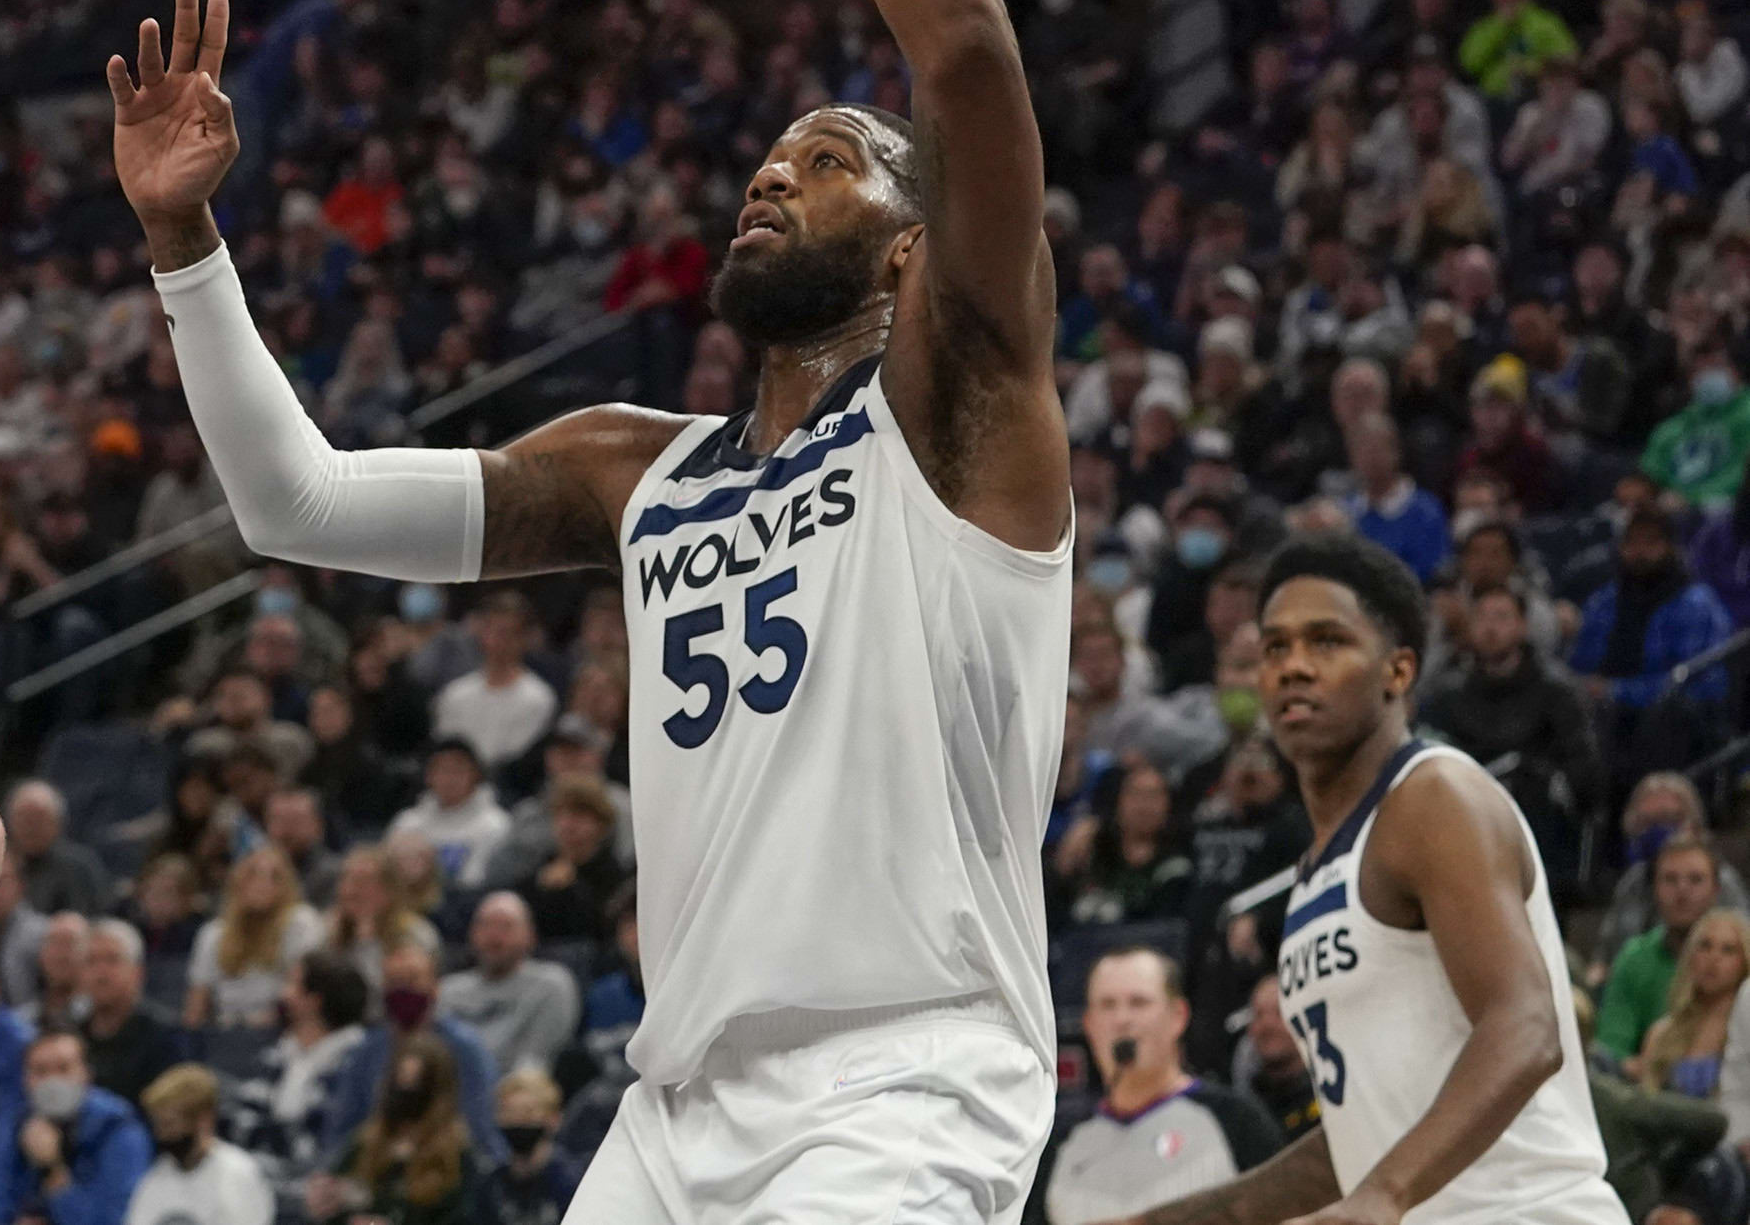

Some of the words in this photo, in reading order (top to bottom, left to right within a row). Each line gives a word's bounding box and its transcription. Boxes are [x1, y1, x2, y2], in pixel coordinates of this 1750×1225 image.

[639, 469, 856, 611] WOLVES
[662, 565, 809, 750] 55
[1278, 927, 1360, 998] OLVES
